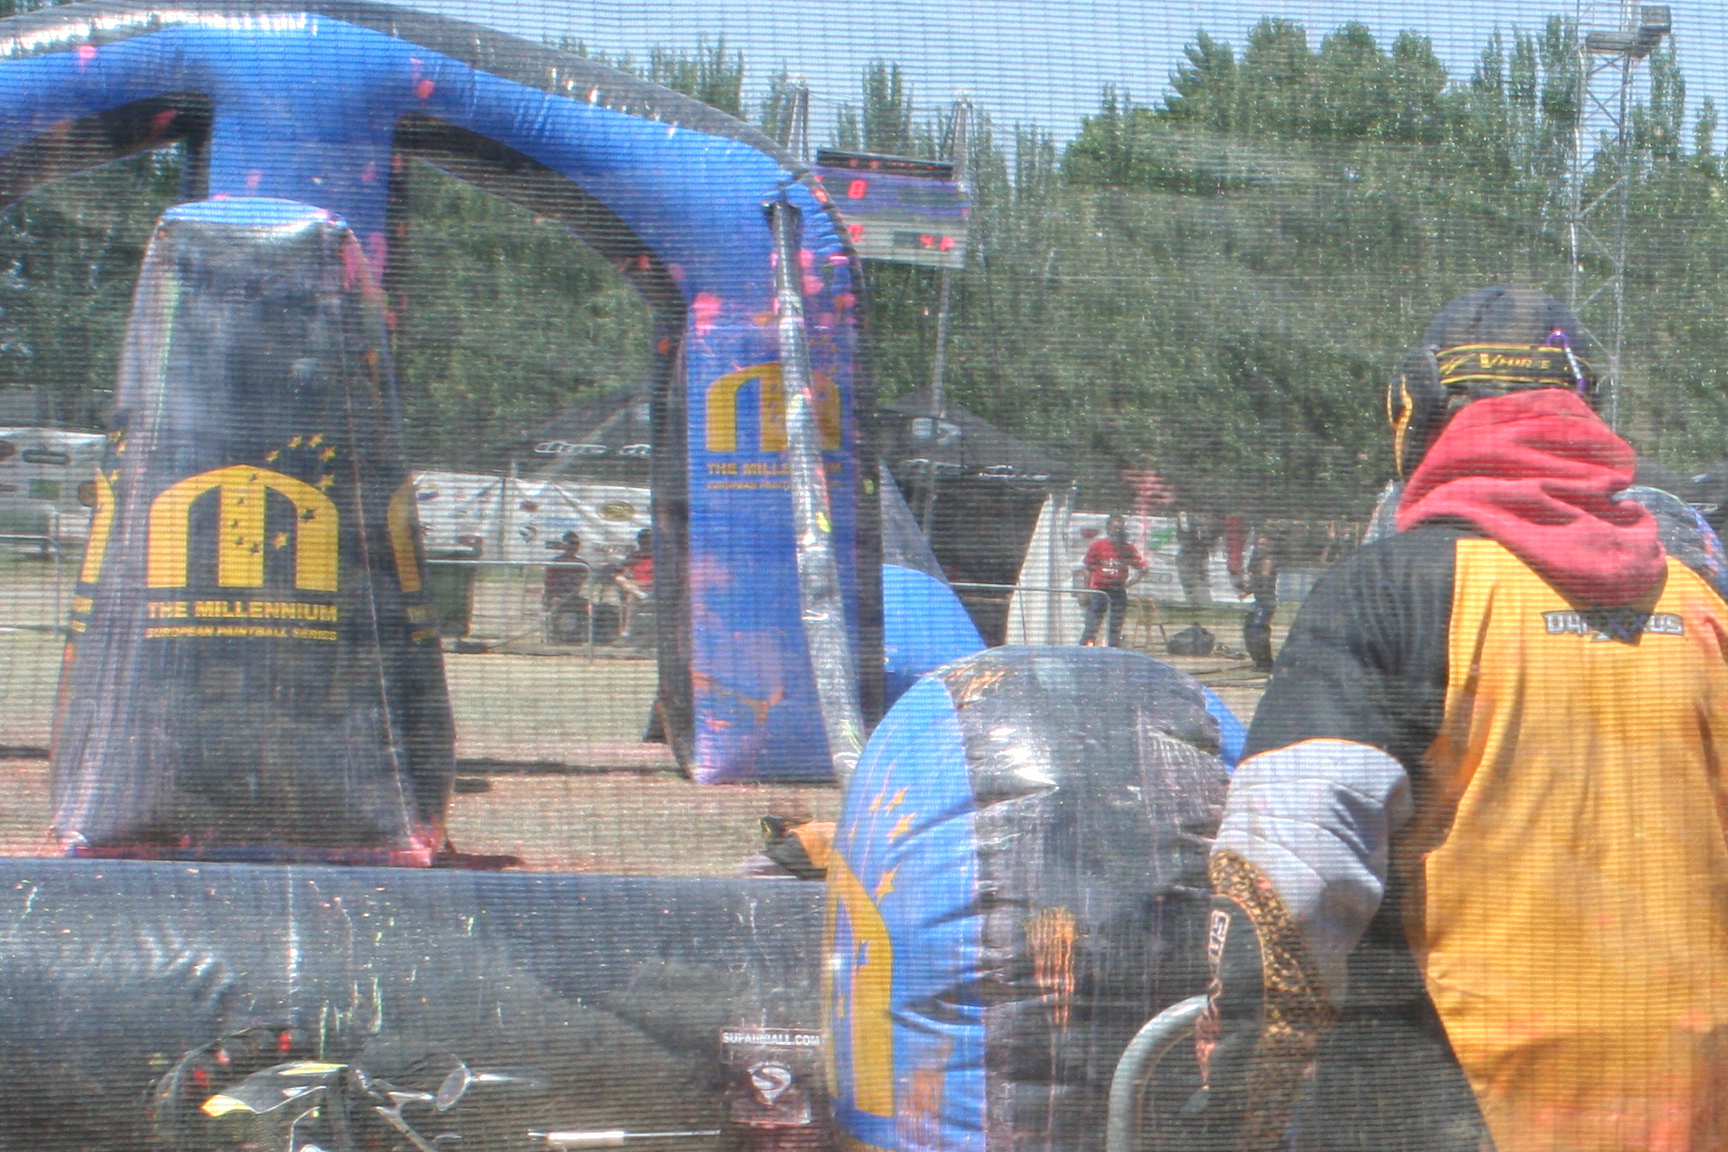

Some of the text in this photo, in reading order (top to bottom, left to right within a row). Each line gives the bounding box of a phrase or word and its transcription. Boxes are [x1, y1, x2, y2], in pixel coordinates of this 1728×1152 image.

[148, 600, 338, 621] THE MILLENNIUM
[145, 626, 214, 638] EUROPEAN
